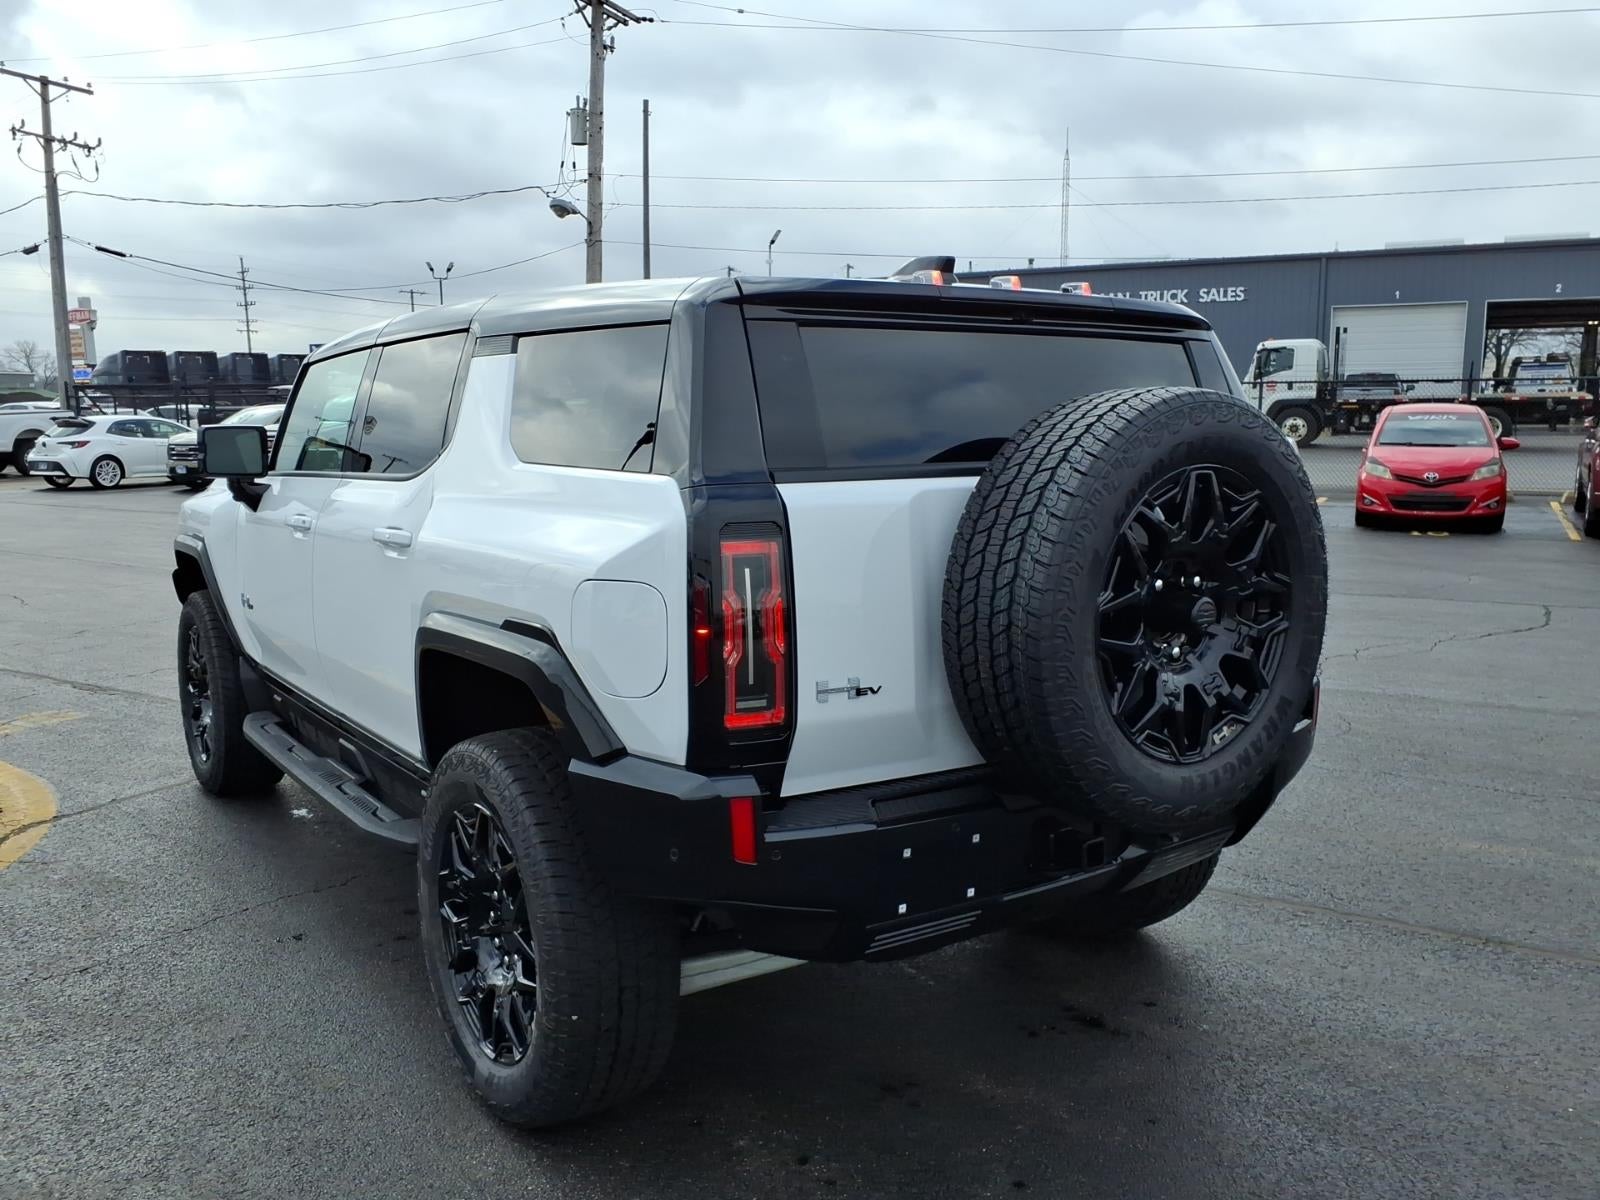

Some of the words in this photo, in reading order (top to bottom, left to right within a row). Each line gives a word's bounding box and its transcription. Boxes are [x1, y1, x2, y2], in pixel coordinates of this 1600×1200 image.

[1555, 283, 1562, 293] 2
[1139, 289, 1188, 303] TRUCK
[1199, 287, 1245, 302] SALES
[1395, 290, 1400, 299] 1
[68, 311, 89, 319] FFMAN
[856, 685, 882, 697] EV
